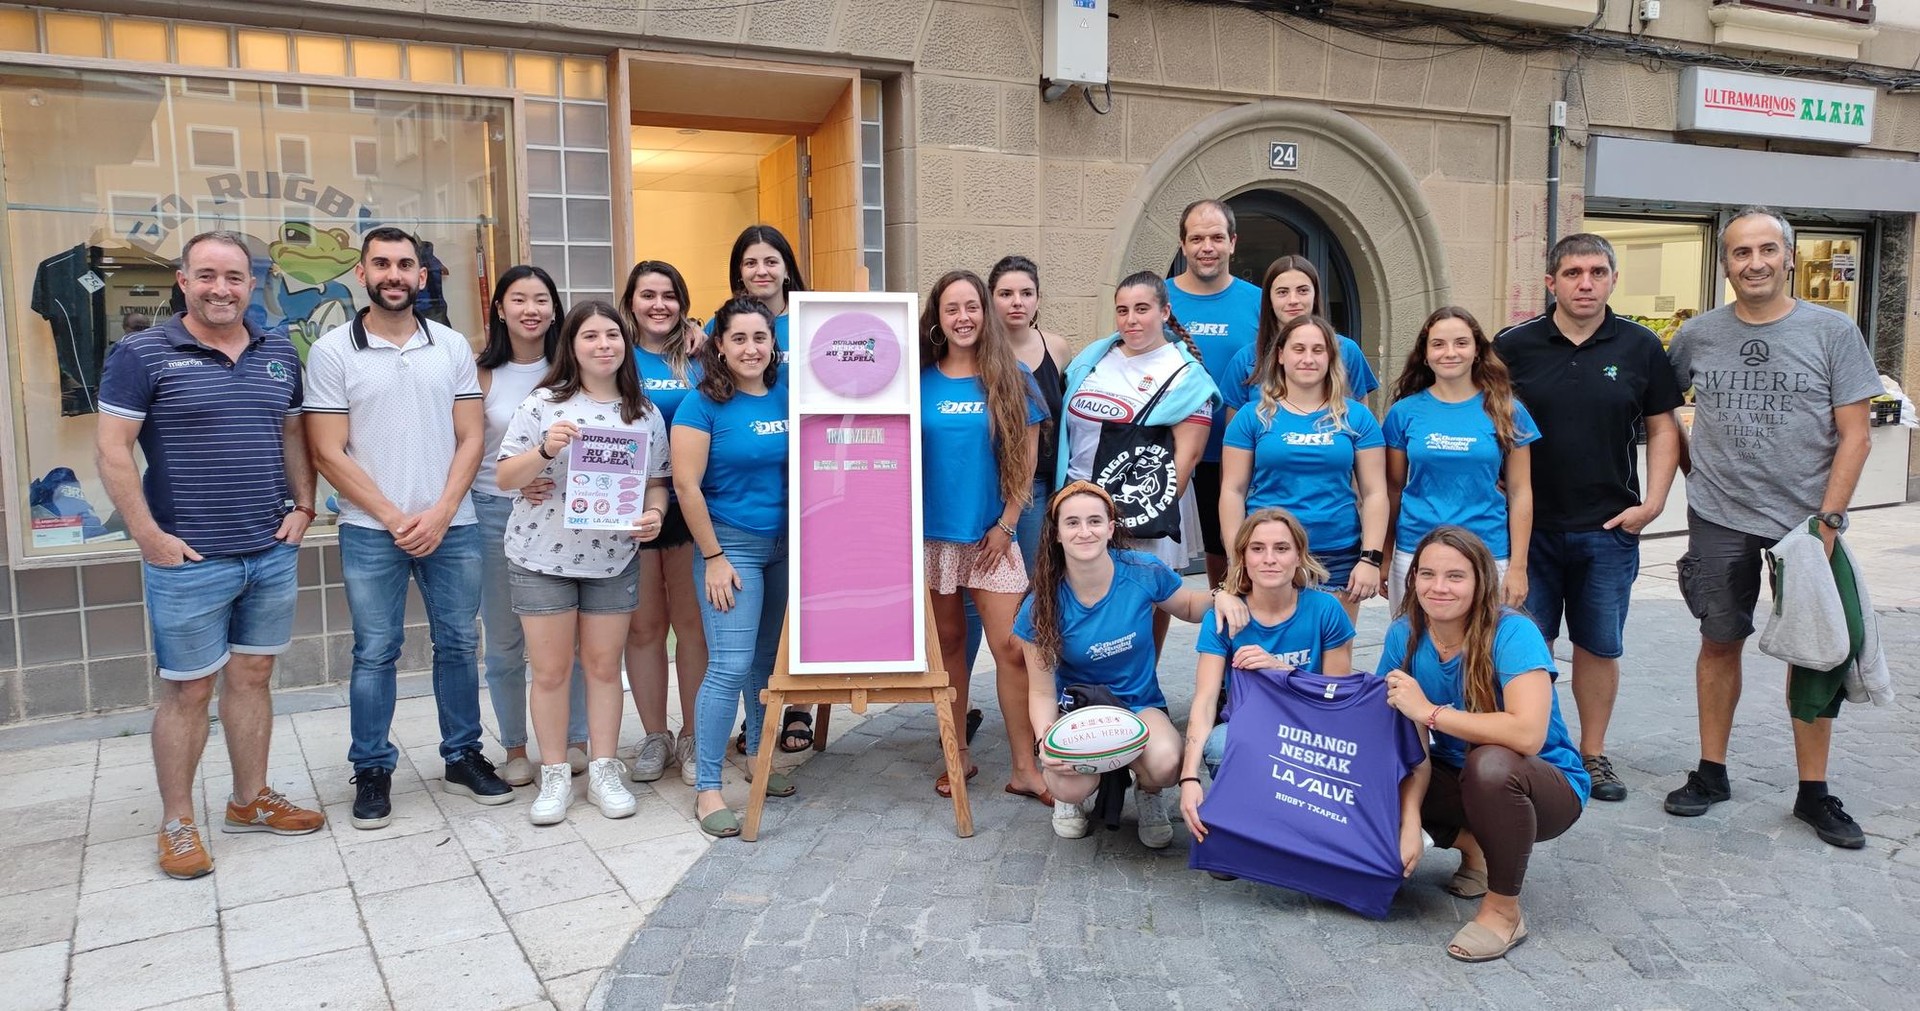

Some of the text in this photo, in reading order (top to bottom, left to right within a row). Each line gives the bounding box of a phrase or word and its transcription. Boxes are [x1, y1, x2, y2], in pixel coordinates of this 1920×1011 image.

[1704, 88, 1796, 112] ULTRAMARINOS
[1273, 146, 1295, 166] 24
[1705, 370, 1811, 393] WHERE
[1074, 398, 1120, 417] MAUCO
[1712, 392, 1794, 412] THERE
[1718, 411, 1789, 425] IS A WILL
[1441, 435, 1477, 443] Durango
[1723, 424, 1775, 438] THERE
[1735, 438, 1762, 449] IS A
[586, 449, 629, 459] RUBY
[1102, 631, 1137, 648] Durango
[1062, 728, 1135, 746] EUSKAL HERRIA
[1277, 724, 1358, 757] DURANGO
[1280, 742, 1352, 774] NESKAK
[1271, 764, 1355, 805] LA SALVE
[1275, 791, 1348, 824] RUGBY TXAPELA
